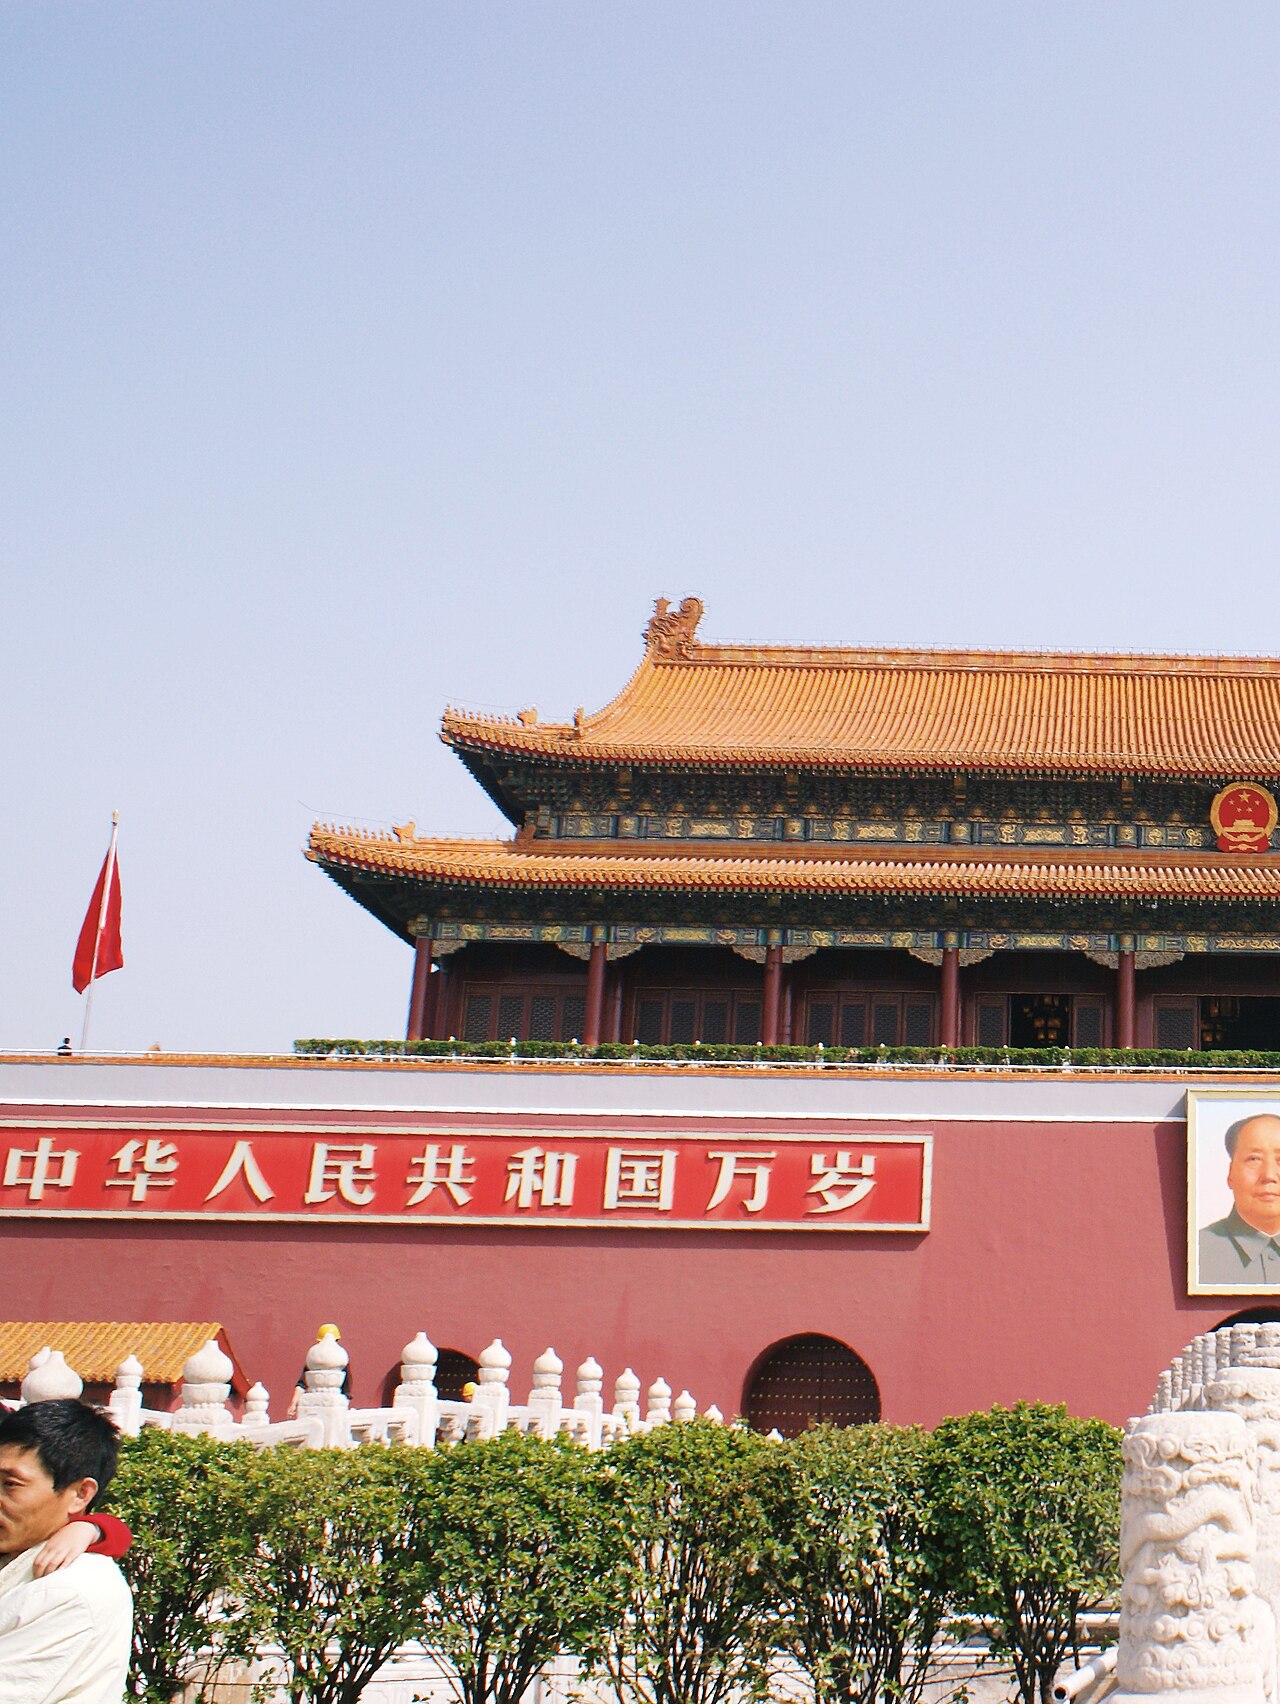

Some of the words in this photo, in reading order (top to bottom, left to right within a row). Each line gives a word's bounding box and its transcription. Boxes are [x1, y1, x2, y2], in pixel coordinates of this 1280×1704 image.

[3, 1137, 877, 1214] 中华人民共和国万岁
